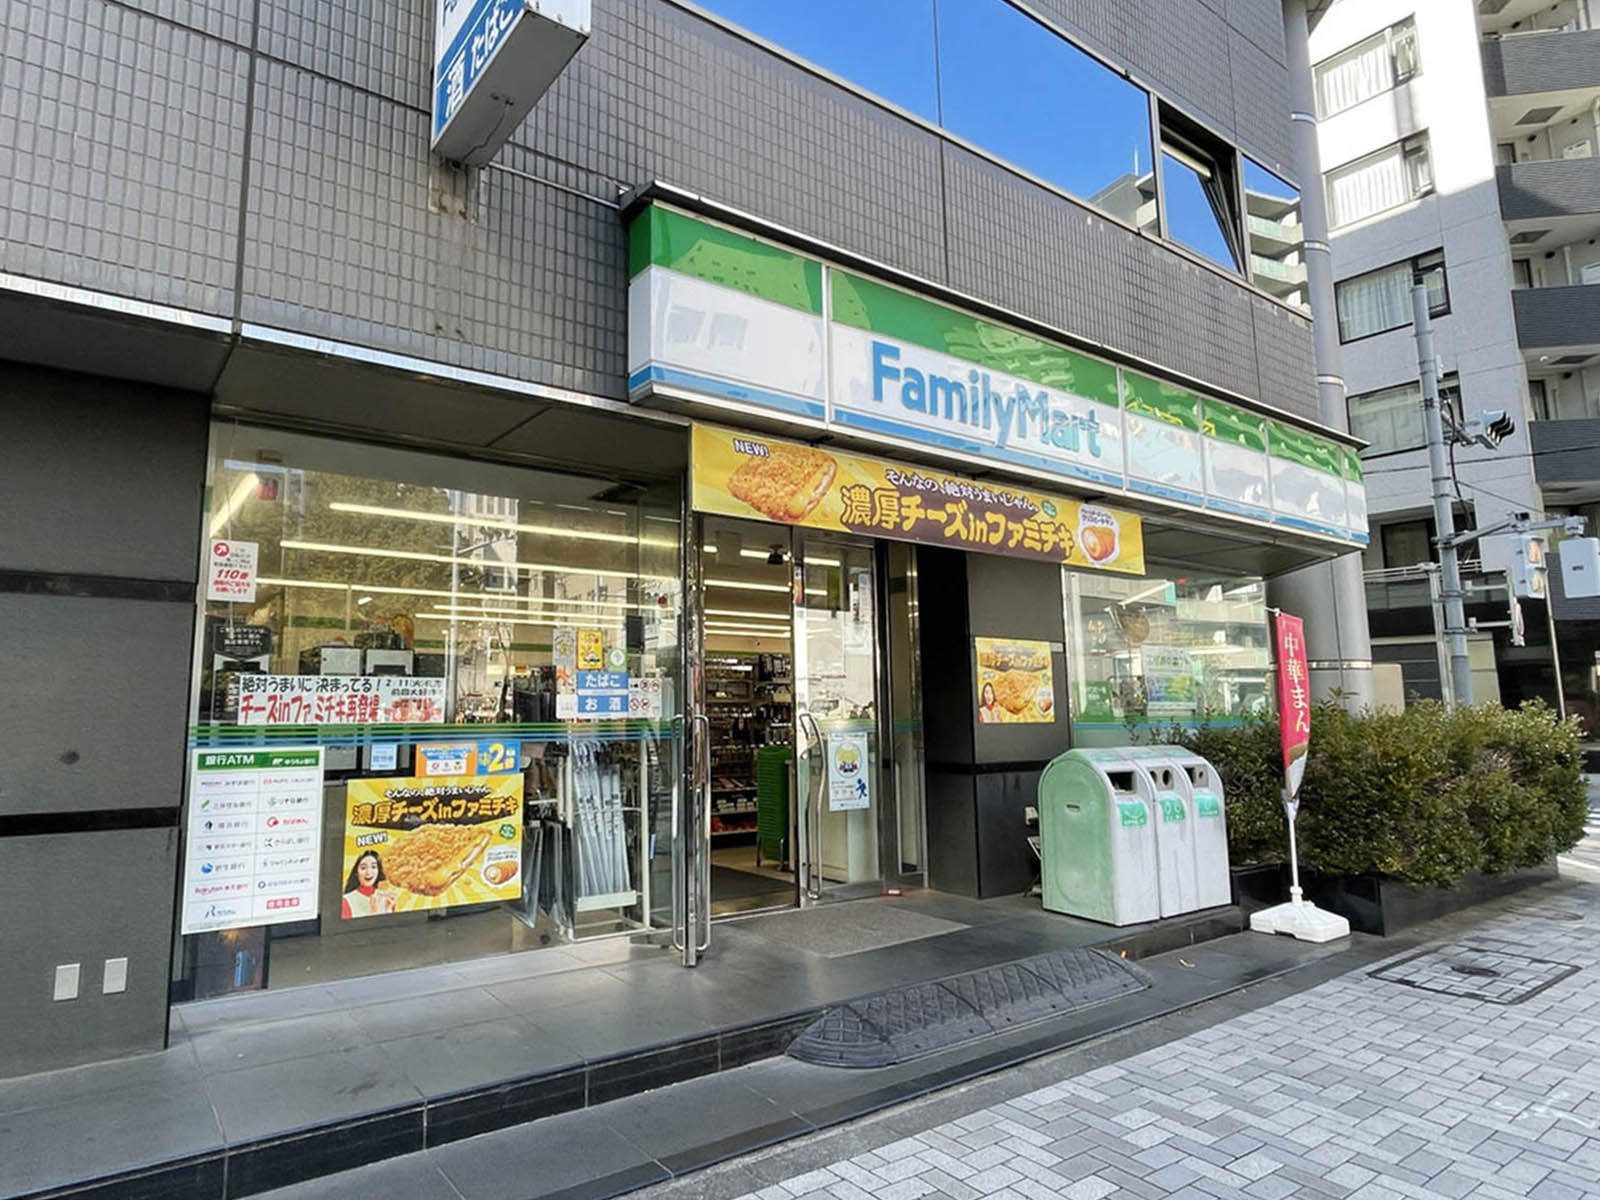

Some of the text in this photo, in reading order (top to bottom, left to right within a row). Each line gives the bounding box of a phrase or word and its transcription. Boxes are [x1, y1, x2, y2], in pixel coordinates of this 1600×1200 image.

[872, 340, 1101, 458] FamilyMart
[734, 439, 769, 458] NEW!
[841, 485, 1075, 557] 濃厚チーズinファミチキ
[585, 673, 621, 688] たばこ
[1284, 631, 1311, 733] 中華まん
[204, 754, 255, 766] 銀行ATM
[352, 796, 518, 825] 濃厚チーズinファミチキ
[357, 832, 388, 847] NEW!
